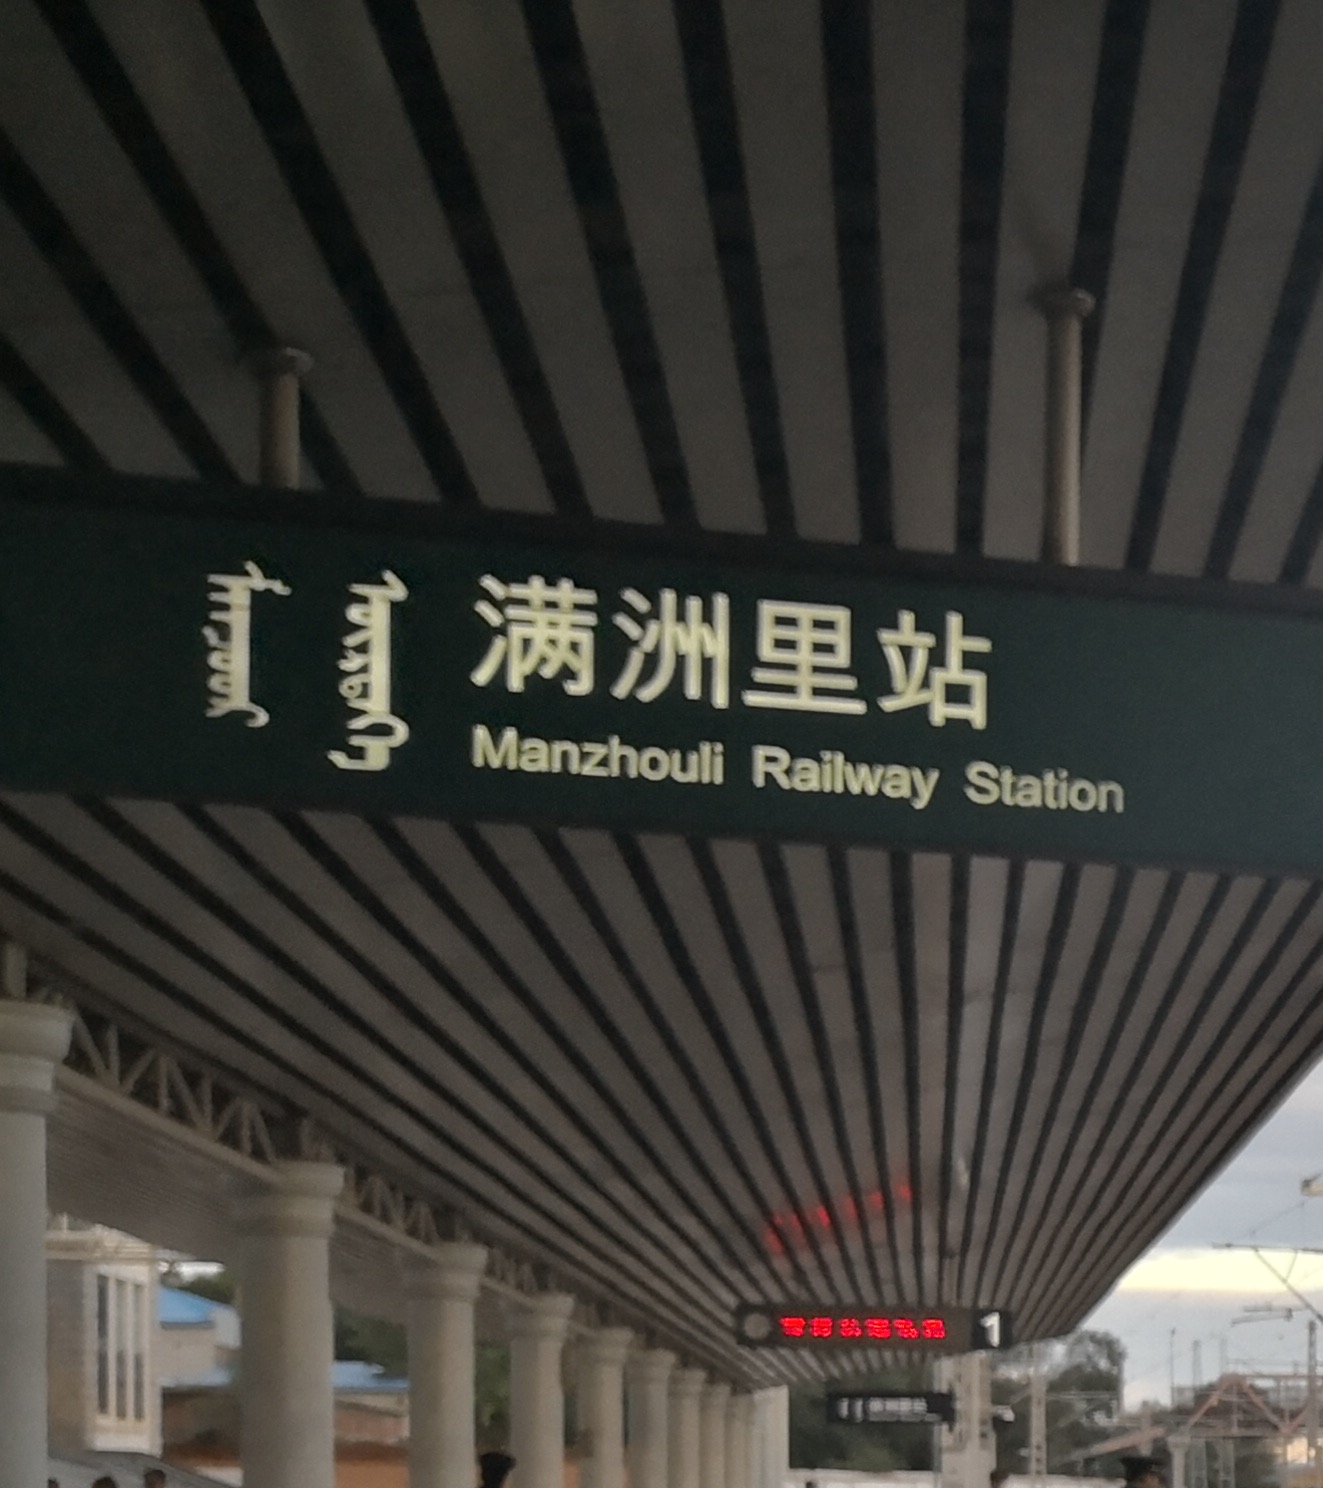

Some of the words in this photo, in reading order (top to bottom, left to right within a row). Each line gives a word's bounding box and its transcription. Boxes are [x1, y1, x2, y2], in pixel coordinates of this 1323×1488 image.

[470, 575, 992, 730] 满洲里站
[471, 724, 724, 785] Manzhouli
[752, 745, 939, 810] Railway
[964, 760, 1125, 814] Station
[979, 1311, 1002, 1349] 1
